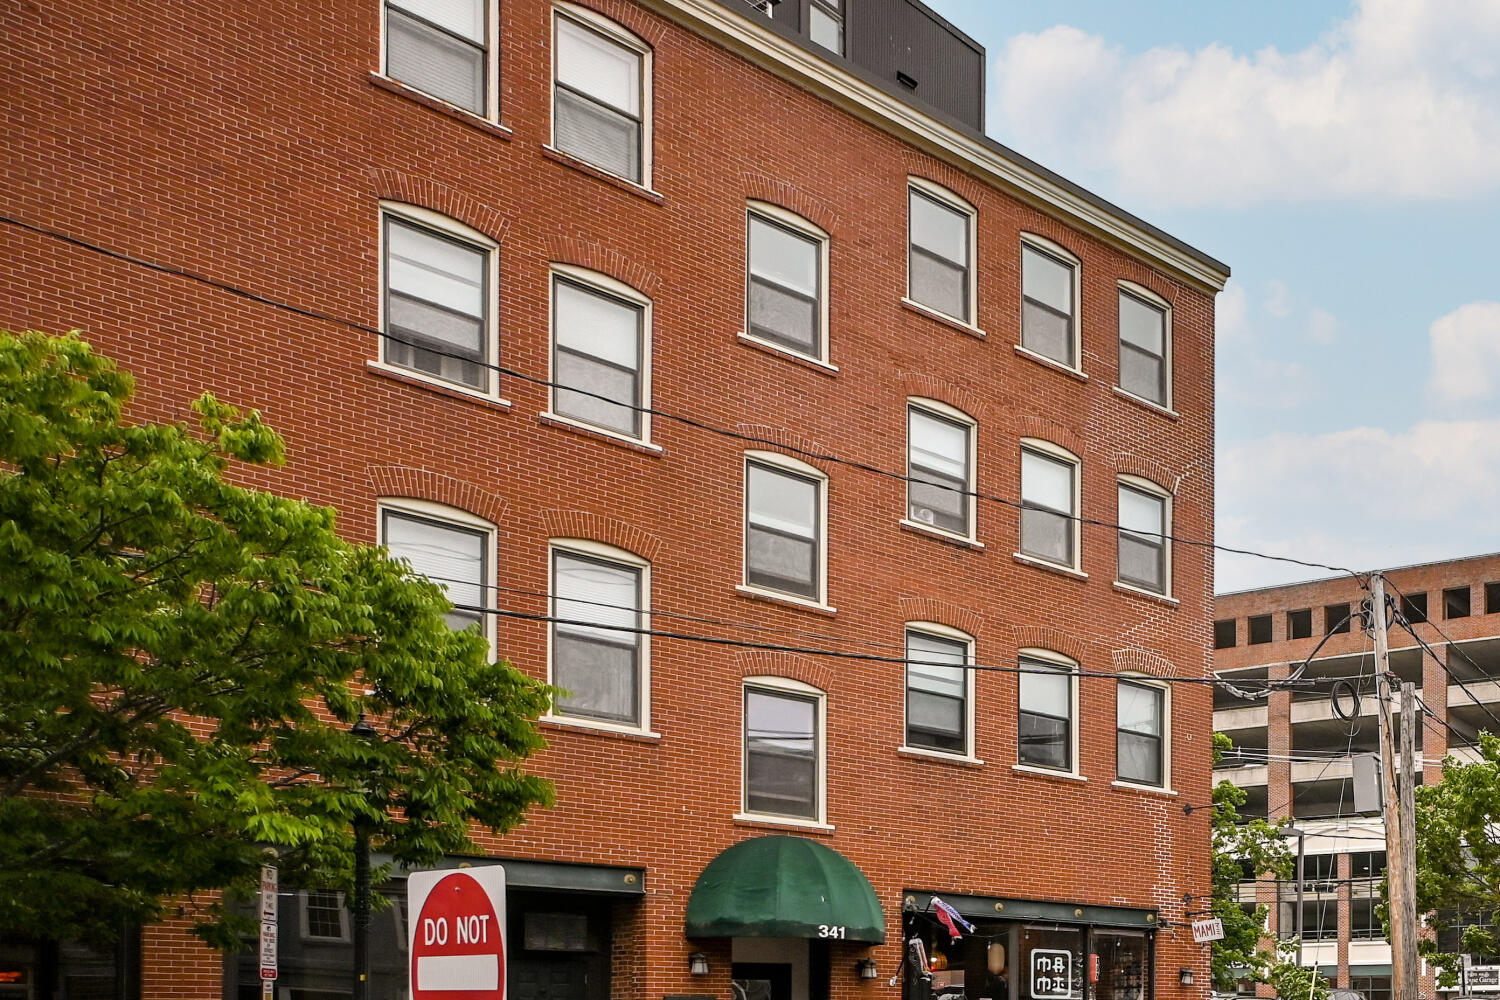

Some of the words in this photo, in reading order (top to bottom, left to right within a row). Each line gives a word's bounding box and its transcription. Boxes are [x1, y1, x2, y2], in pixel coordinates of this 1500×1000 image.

[424, 917, 448, 946] DO
[456, 915, 490, 945] NOT
[818, 925, 846, 940] 341
[1194, 923, 1216, 938] MAMI
